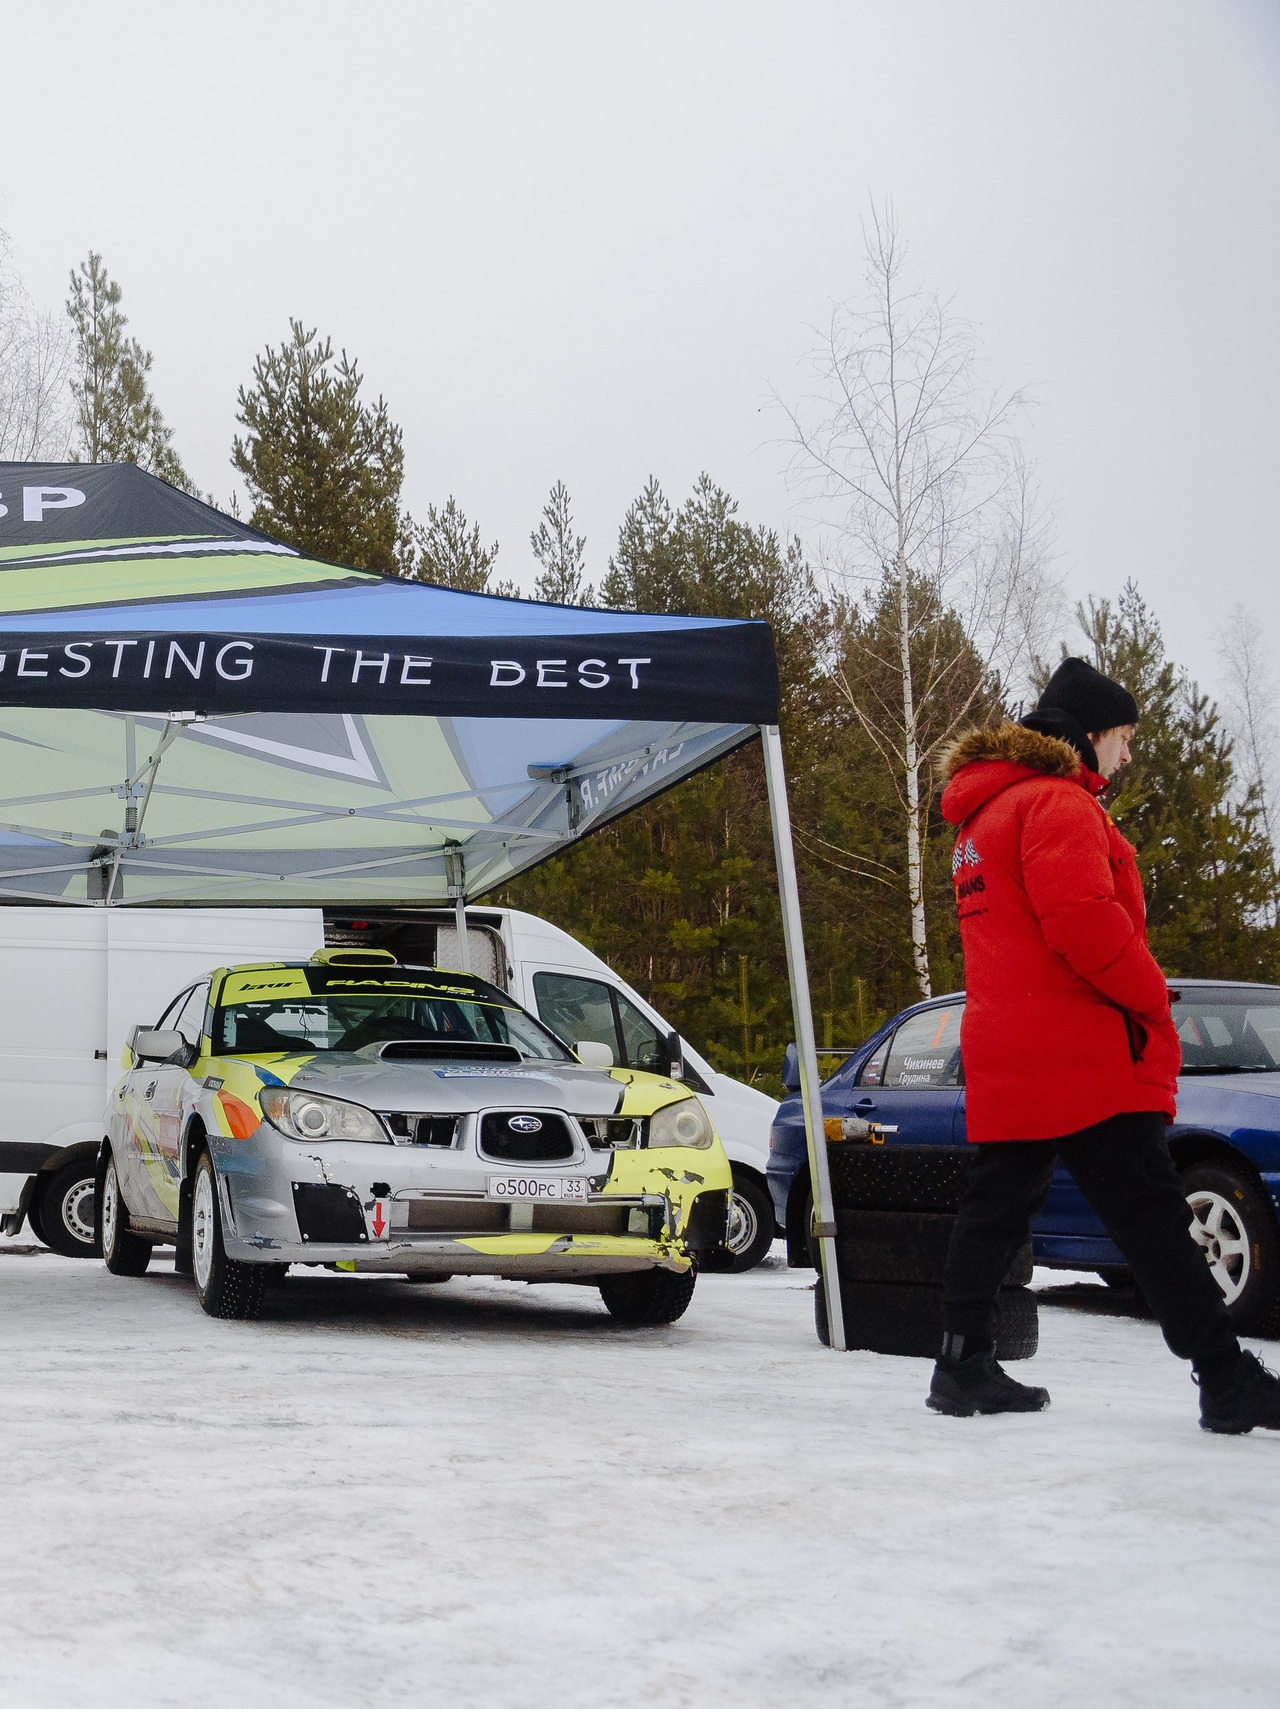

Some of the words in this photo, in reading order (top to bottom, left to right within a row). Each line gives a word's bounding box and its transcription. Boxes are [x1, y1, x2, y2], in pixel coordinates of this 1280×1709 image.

[313, 646, 433, 686] THE
[490, 658, 651, 689] BEST
[904, 1057, 945, 1070] Чикинев
[899, 1072, 931, 1085] Грудина
[566, 1180, 581, 1192] 33
